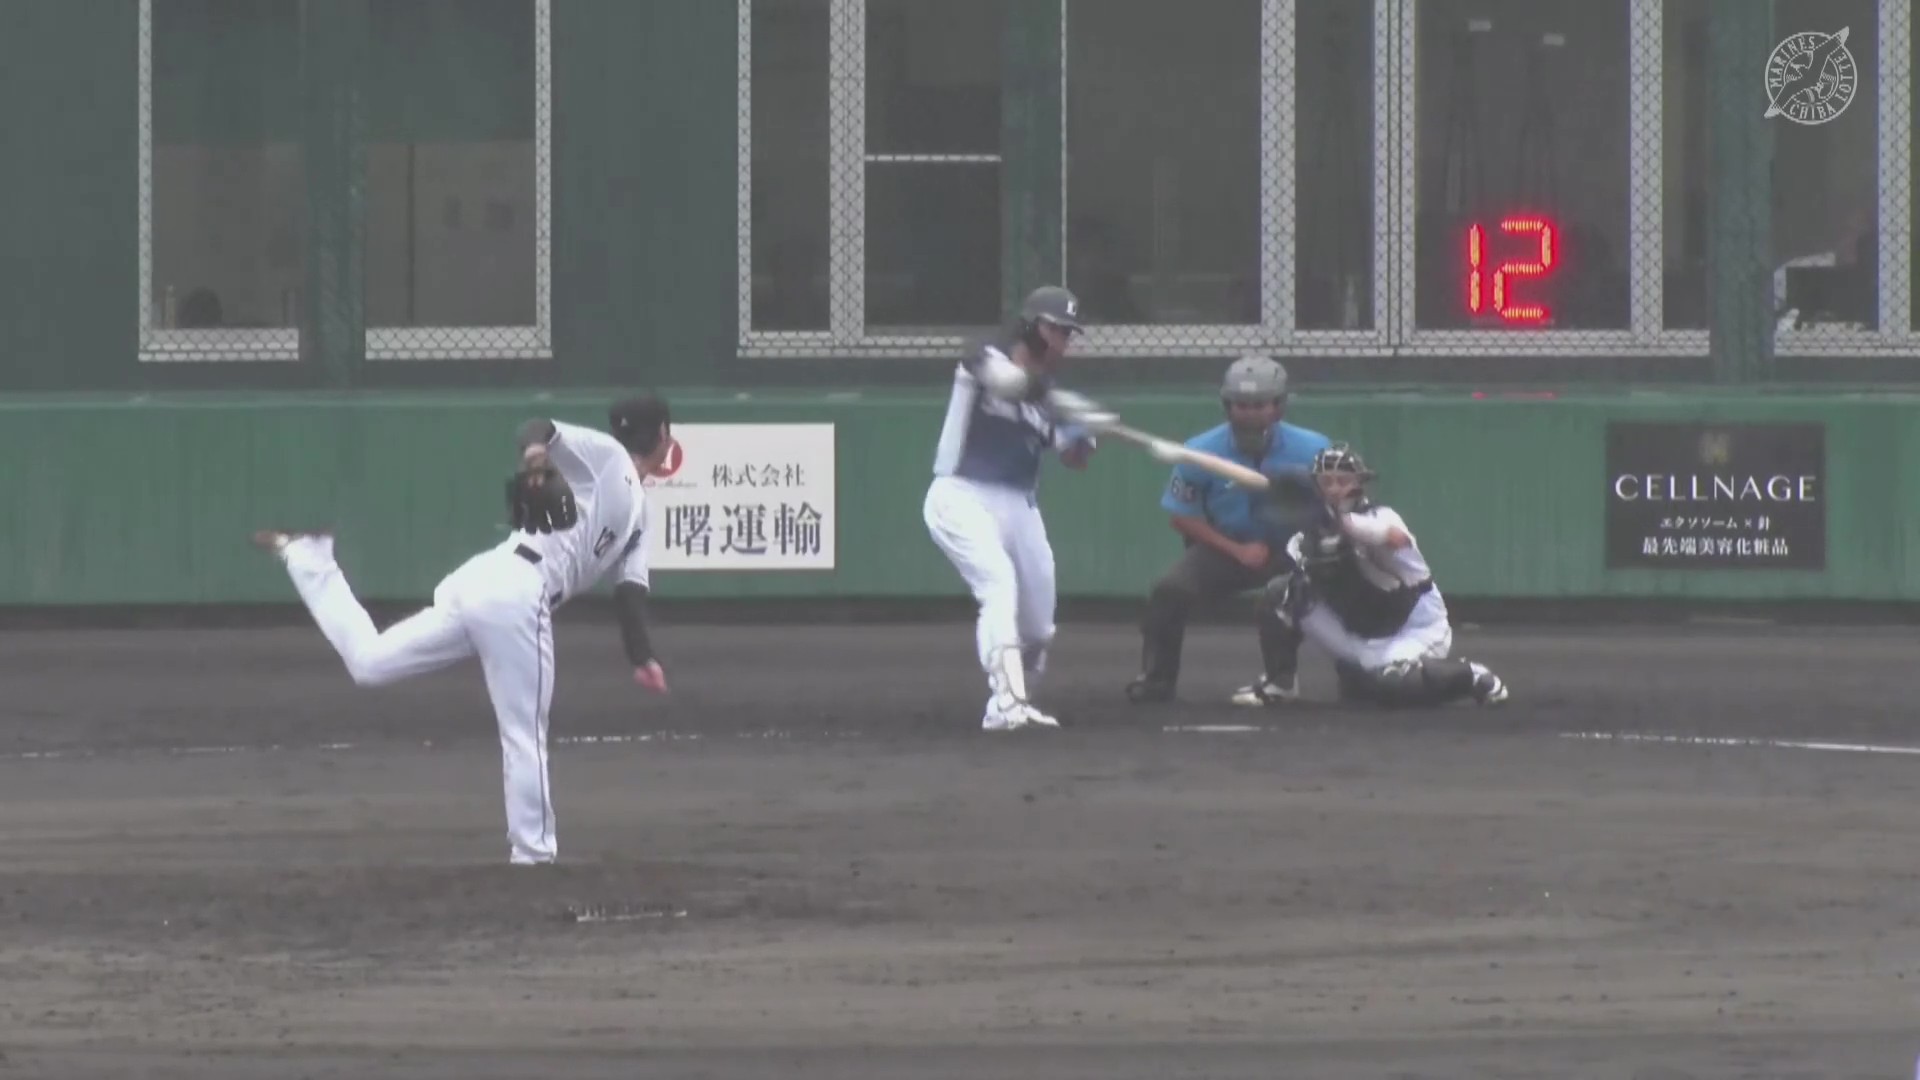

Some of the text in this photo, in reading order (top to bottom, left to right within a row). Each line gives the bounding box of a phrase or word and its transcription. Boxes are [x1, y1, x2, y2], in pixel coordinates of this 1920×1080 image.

[1469, 219, 1552, 319] 12
[712, 462, 806, 487] 株式会社
[1615, 474, 1817, 501] CELLNAGE
[665, 501, 823, 556] 曙運輸
[1642, 536, 1789, 556] 最先端美容化粧品
